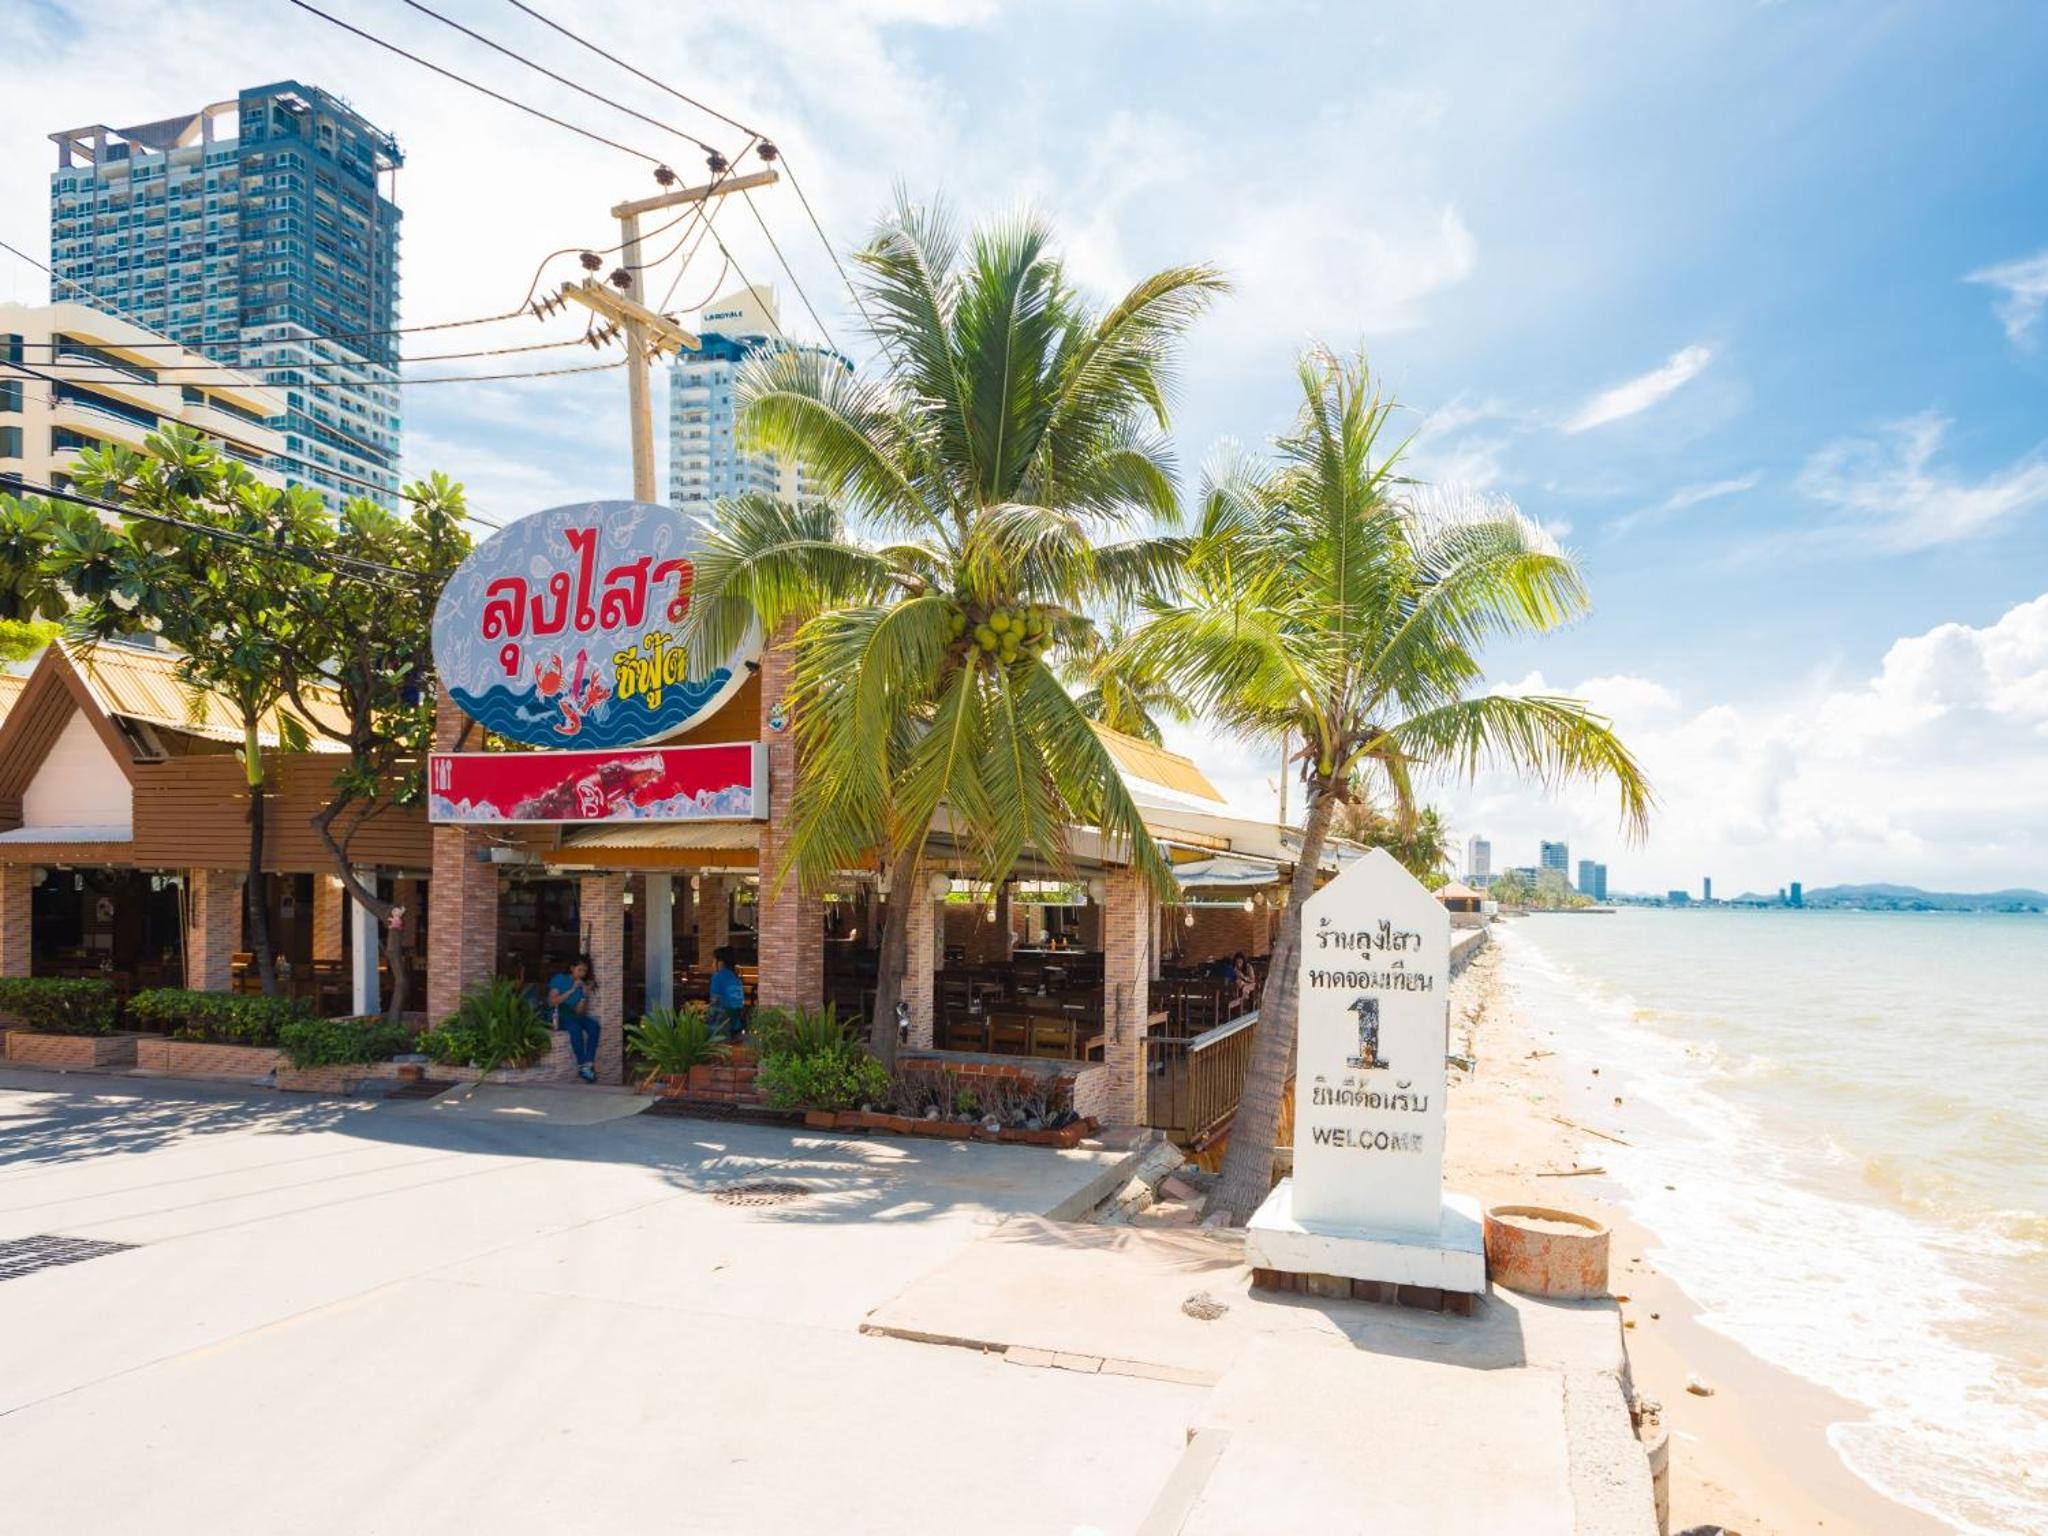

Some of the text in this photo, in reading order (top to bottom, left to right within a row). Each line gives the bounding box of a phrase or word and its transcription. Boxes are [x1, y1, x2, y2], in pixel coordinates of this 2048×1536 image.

[482, 527, 696, 677] ลุงไสว
[1316, 917, 1421, 960] ร้านลุงไสว
[1308, 960, 1433, 992] หาดจอมเทียน
[1347, 998, 1390, 1070] 1
[1312, 1126, 1423, 1152] WELCOME
